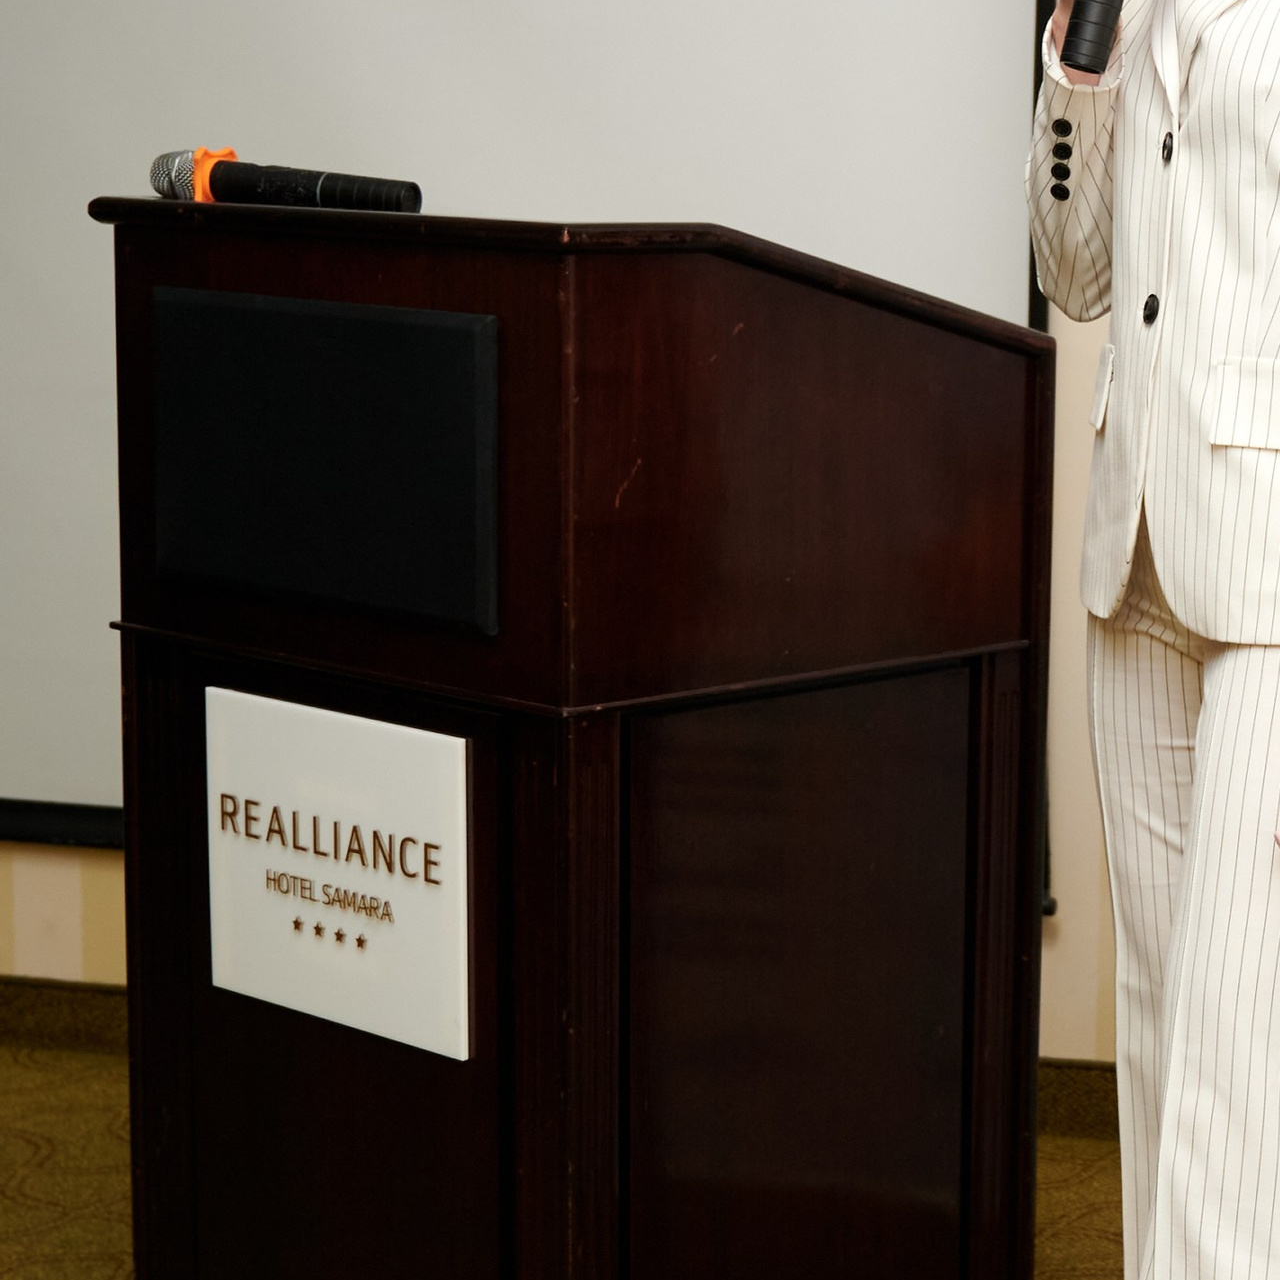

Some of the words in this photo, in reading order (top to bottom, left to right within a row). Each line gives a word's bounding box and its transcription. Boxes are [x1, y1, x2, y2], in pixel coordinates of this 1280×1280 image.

[220, 793, 442, 885] REALLIANCE
[266, 868, 319, 902] HOTEL
[322, 883, 394, 923] SAMARA
